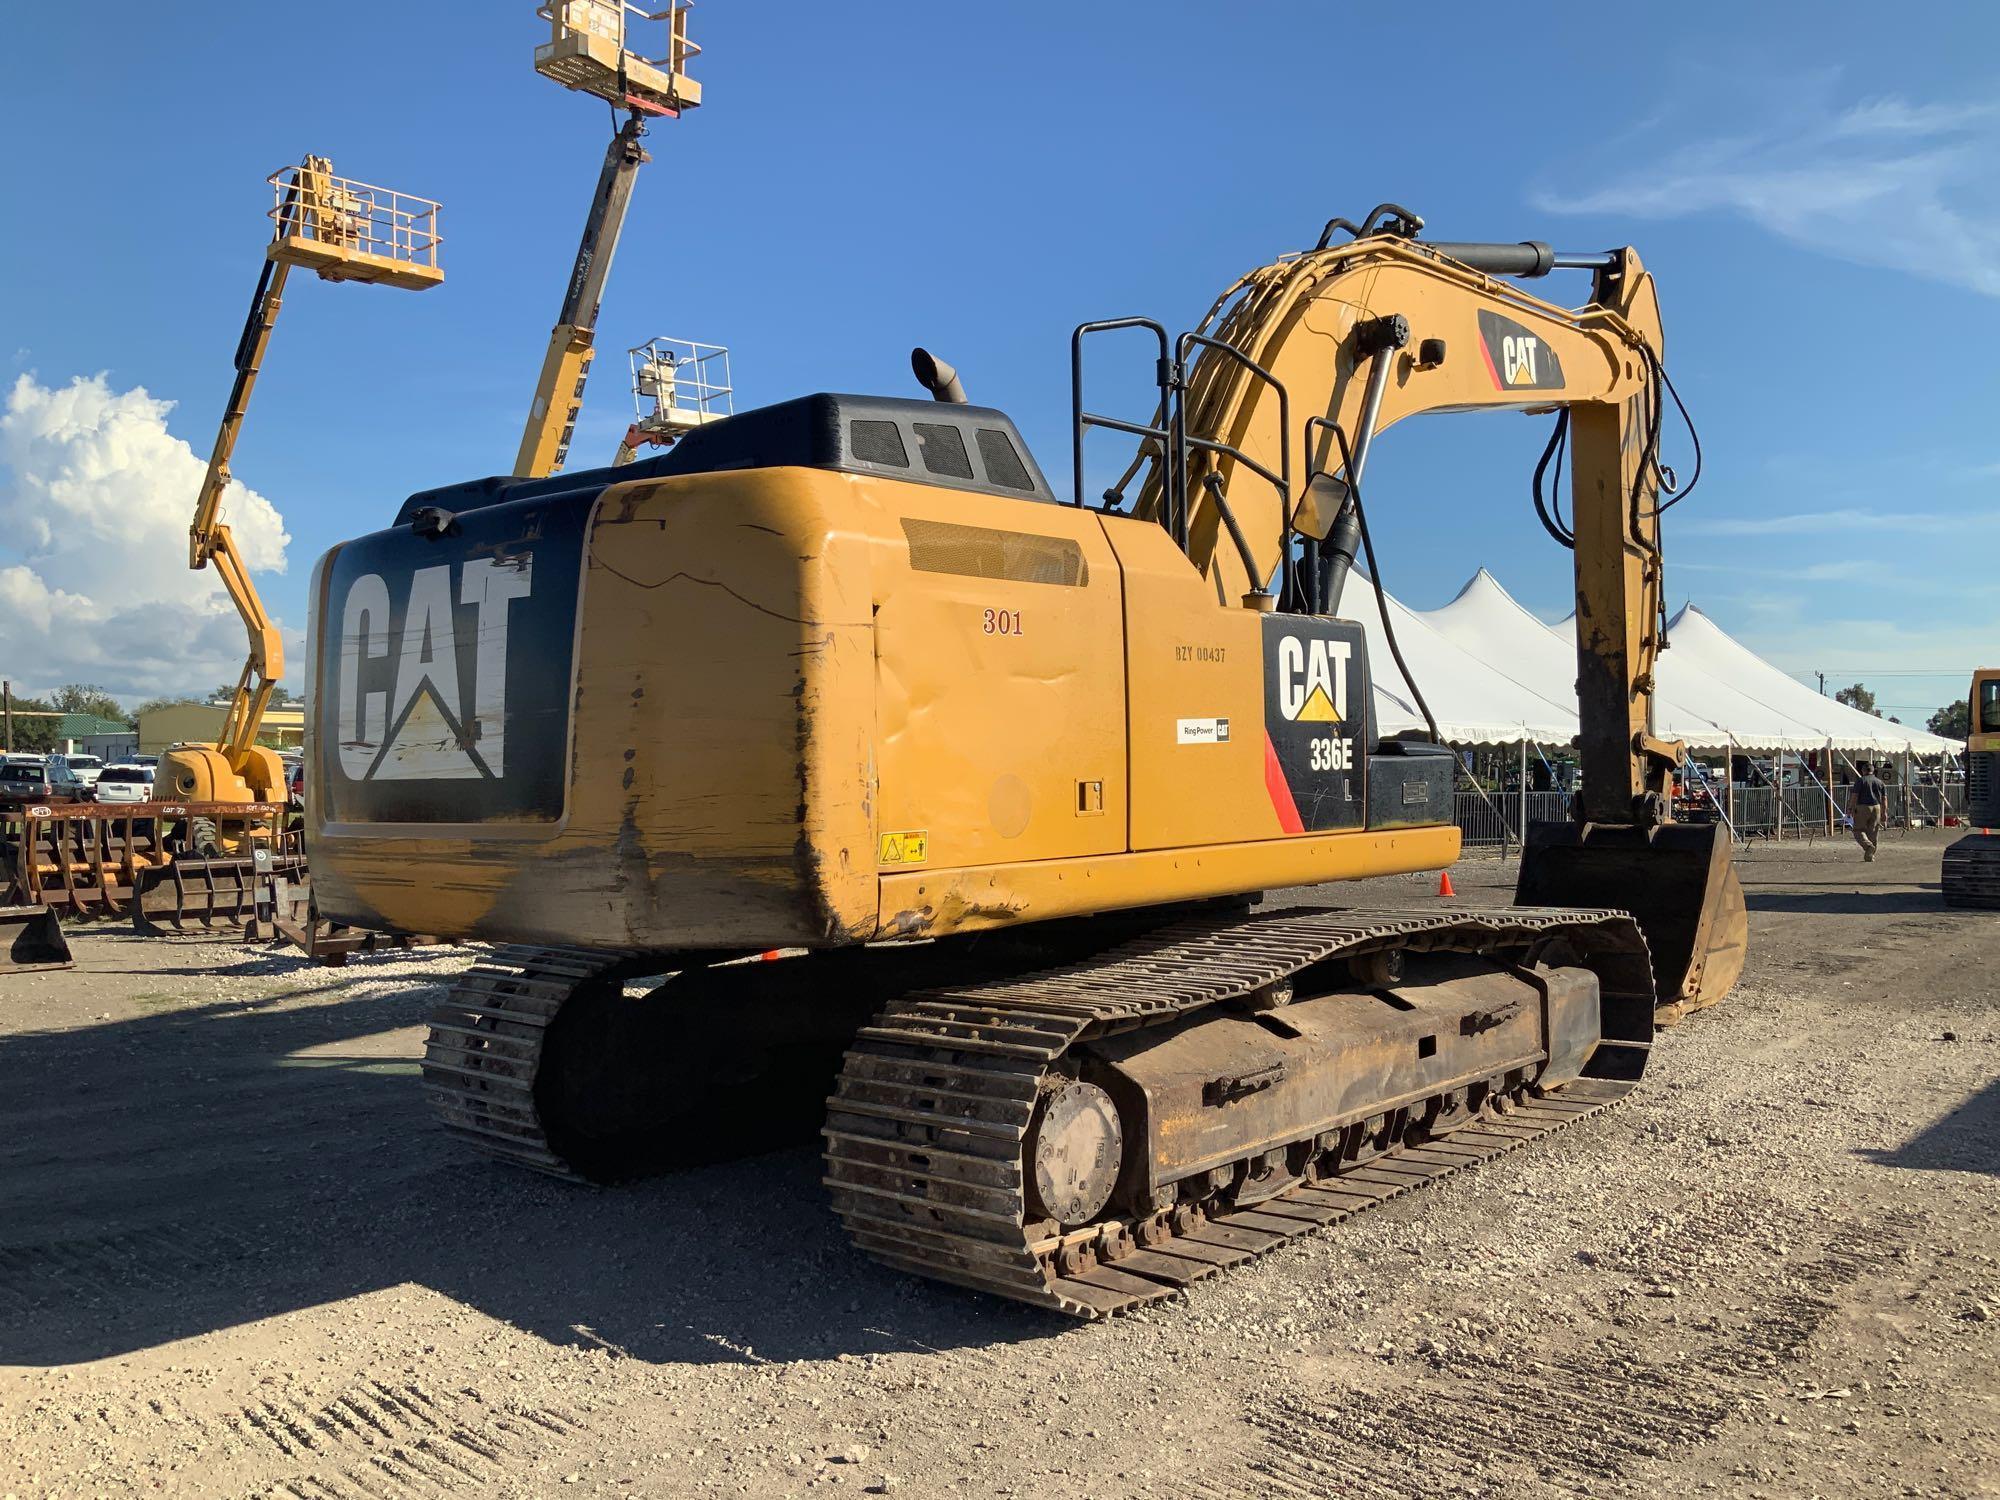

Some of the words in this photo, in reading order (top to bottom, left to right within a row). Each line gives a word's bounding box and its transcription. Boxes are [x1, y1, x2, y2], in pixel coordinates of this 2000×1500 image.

[1503, 336, 1536, 384] CAT
[983, 608, 1023, 636] 301
[338, 552, 533, 781] CAT
[1196, 648, 1225, 663] 00437
[1279, 636, 1351, 722] CAT
[1310, 738, 1353, 770] 336E
[1344, 779, 1352, 802] L
